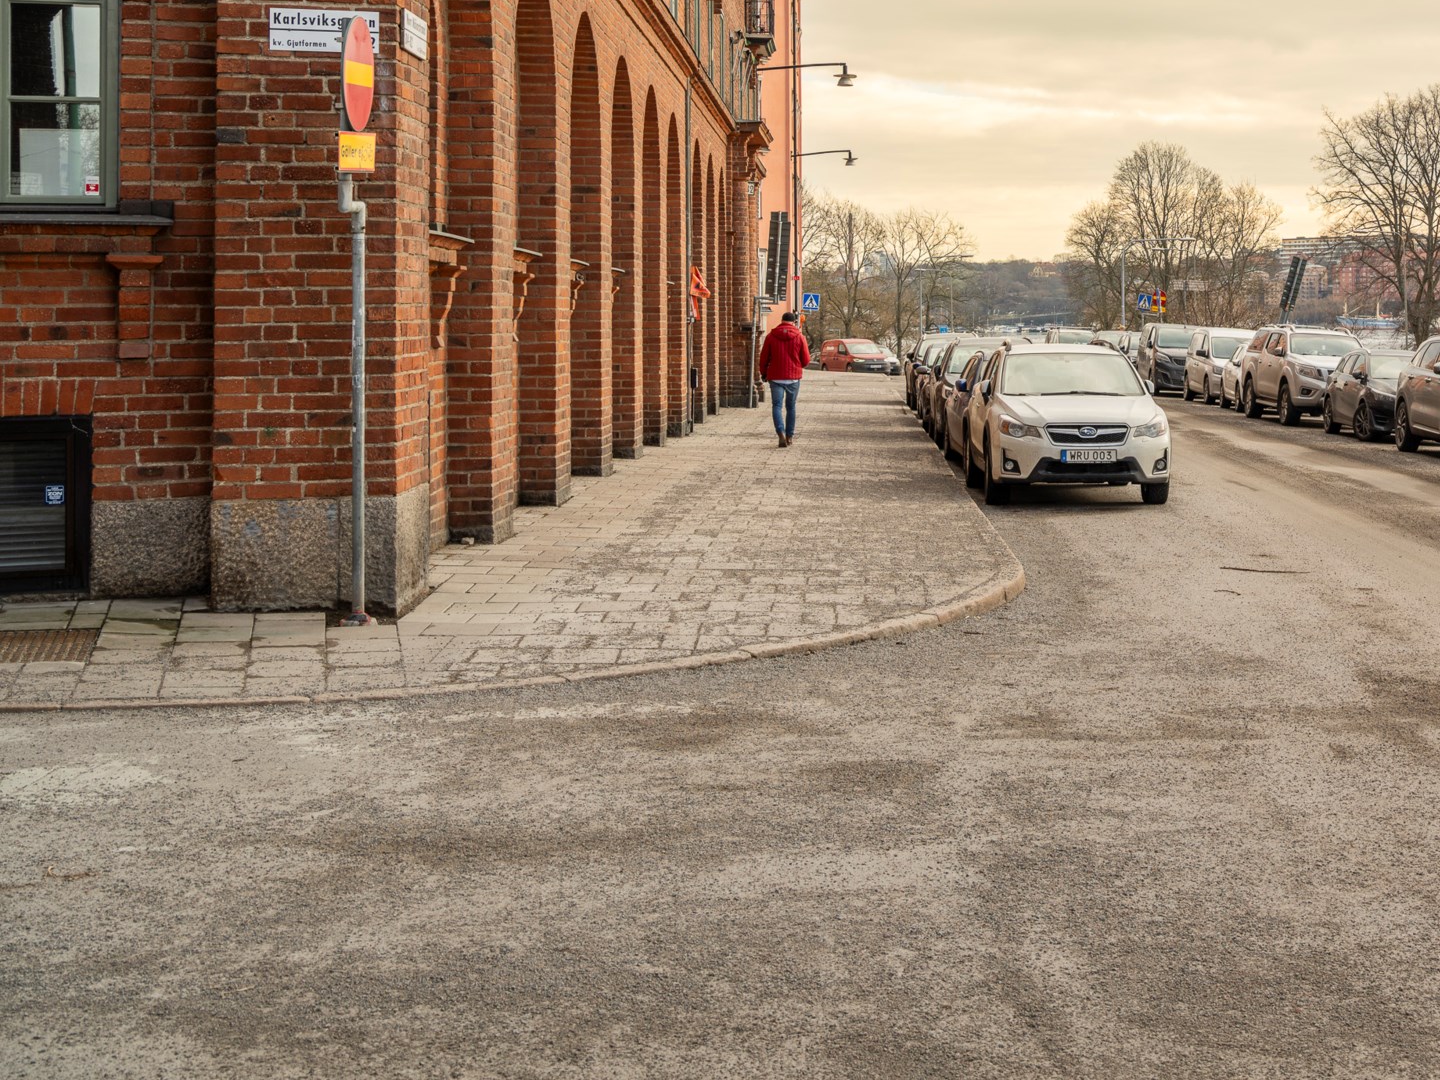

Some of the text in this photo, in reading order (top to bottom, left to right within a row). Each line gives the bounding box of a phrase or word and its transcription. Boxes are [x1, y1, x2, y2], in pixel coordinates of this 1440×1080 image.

[273, 12, 376, 29] Karlsviksgn
[273, 38, 327, 48] kv. Gjutformen
[1070, 451, 1112, 460] WRU 003
